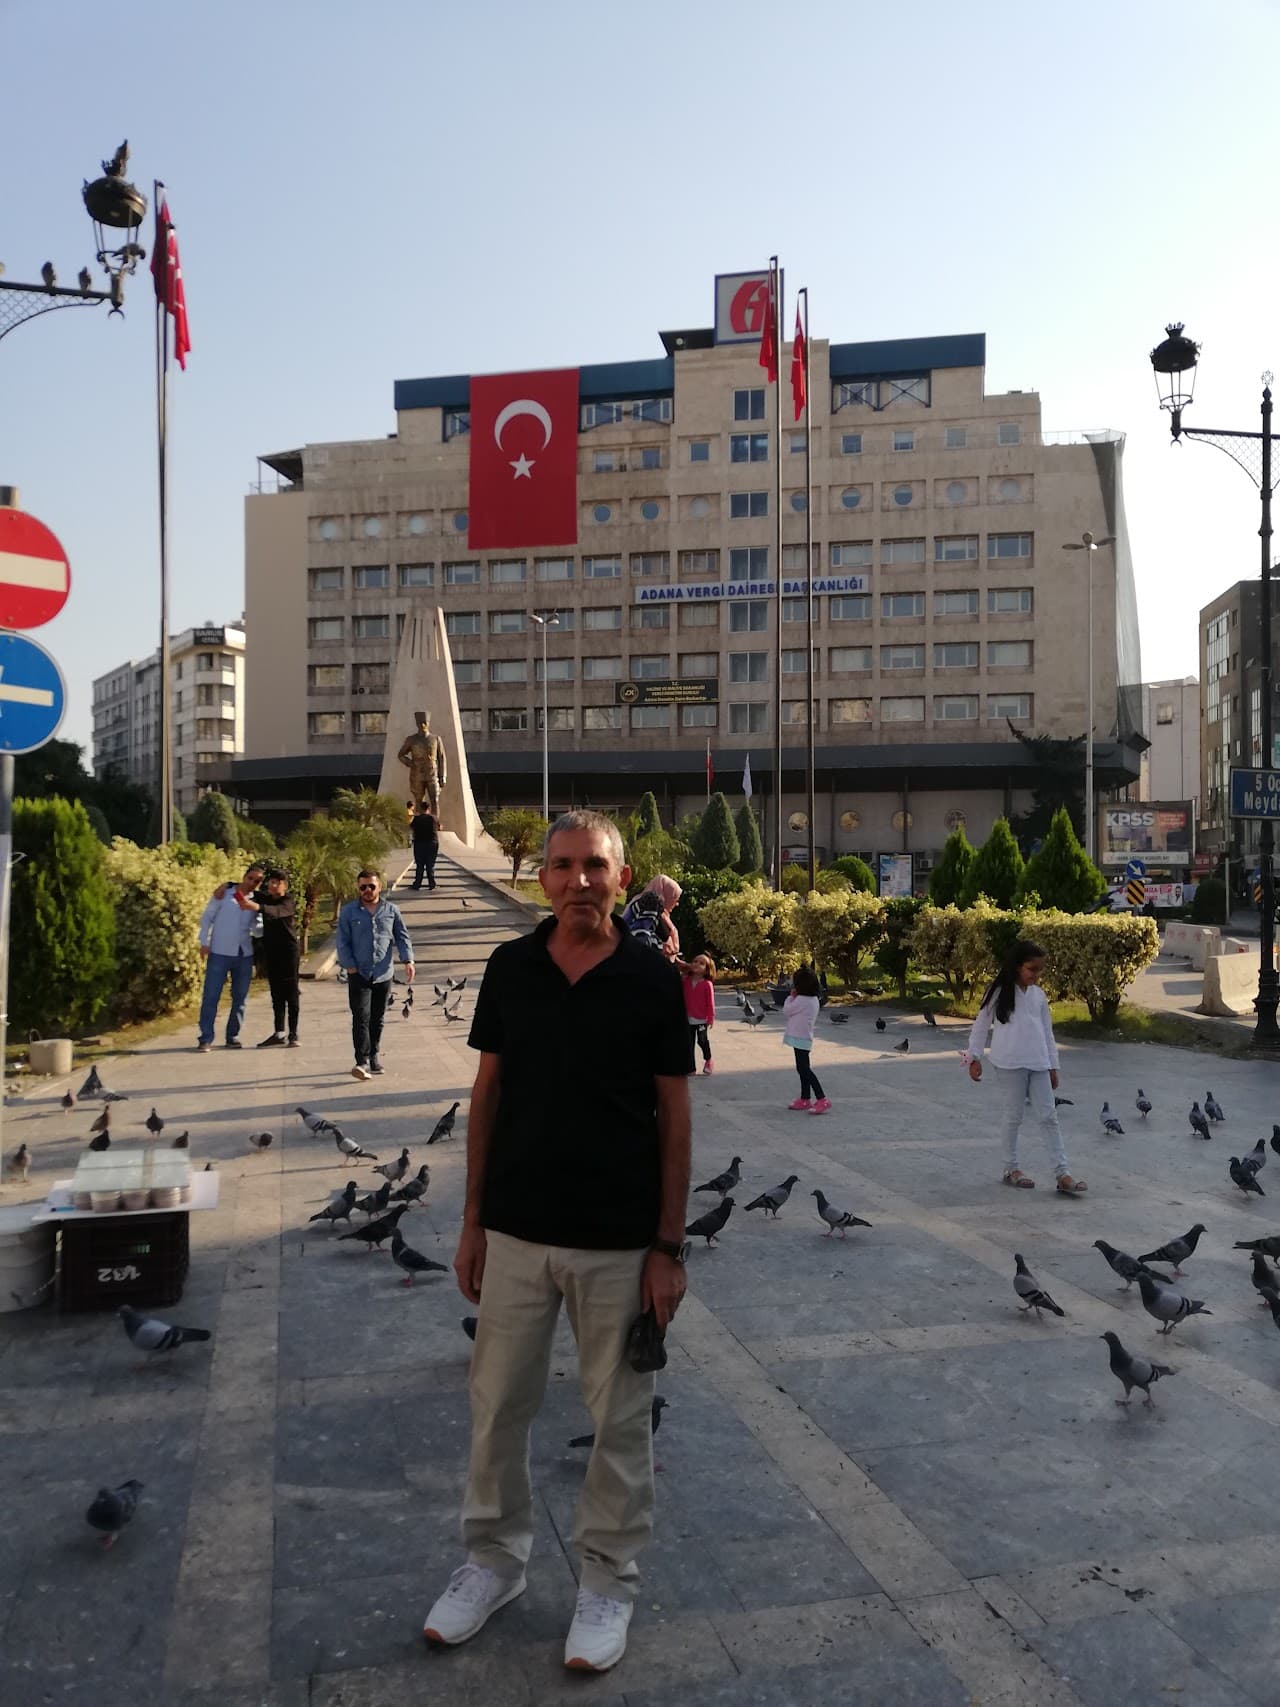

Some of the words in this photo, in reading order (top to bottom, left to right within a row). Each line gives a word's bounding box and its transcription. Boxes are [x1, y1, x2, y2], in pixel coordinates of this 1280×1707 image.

[640, 588, 684, 600] ADANA
[687, 584, 724, 598] VERGİ
[1255, 774, 1262, 790] 5
[1244, 792, 1280, 813] Meyd
[1106, 811, 1154, 827] KPSS
